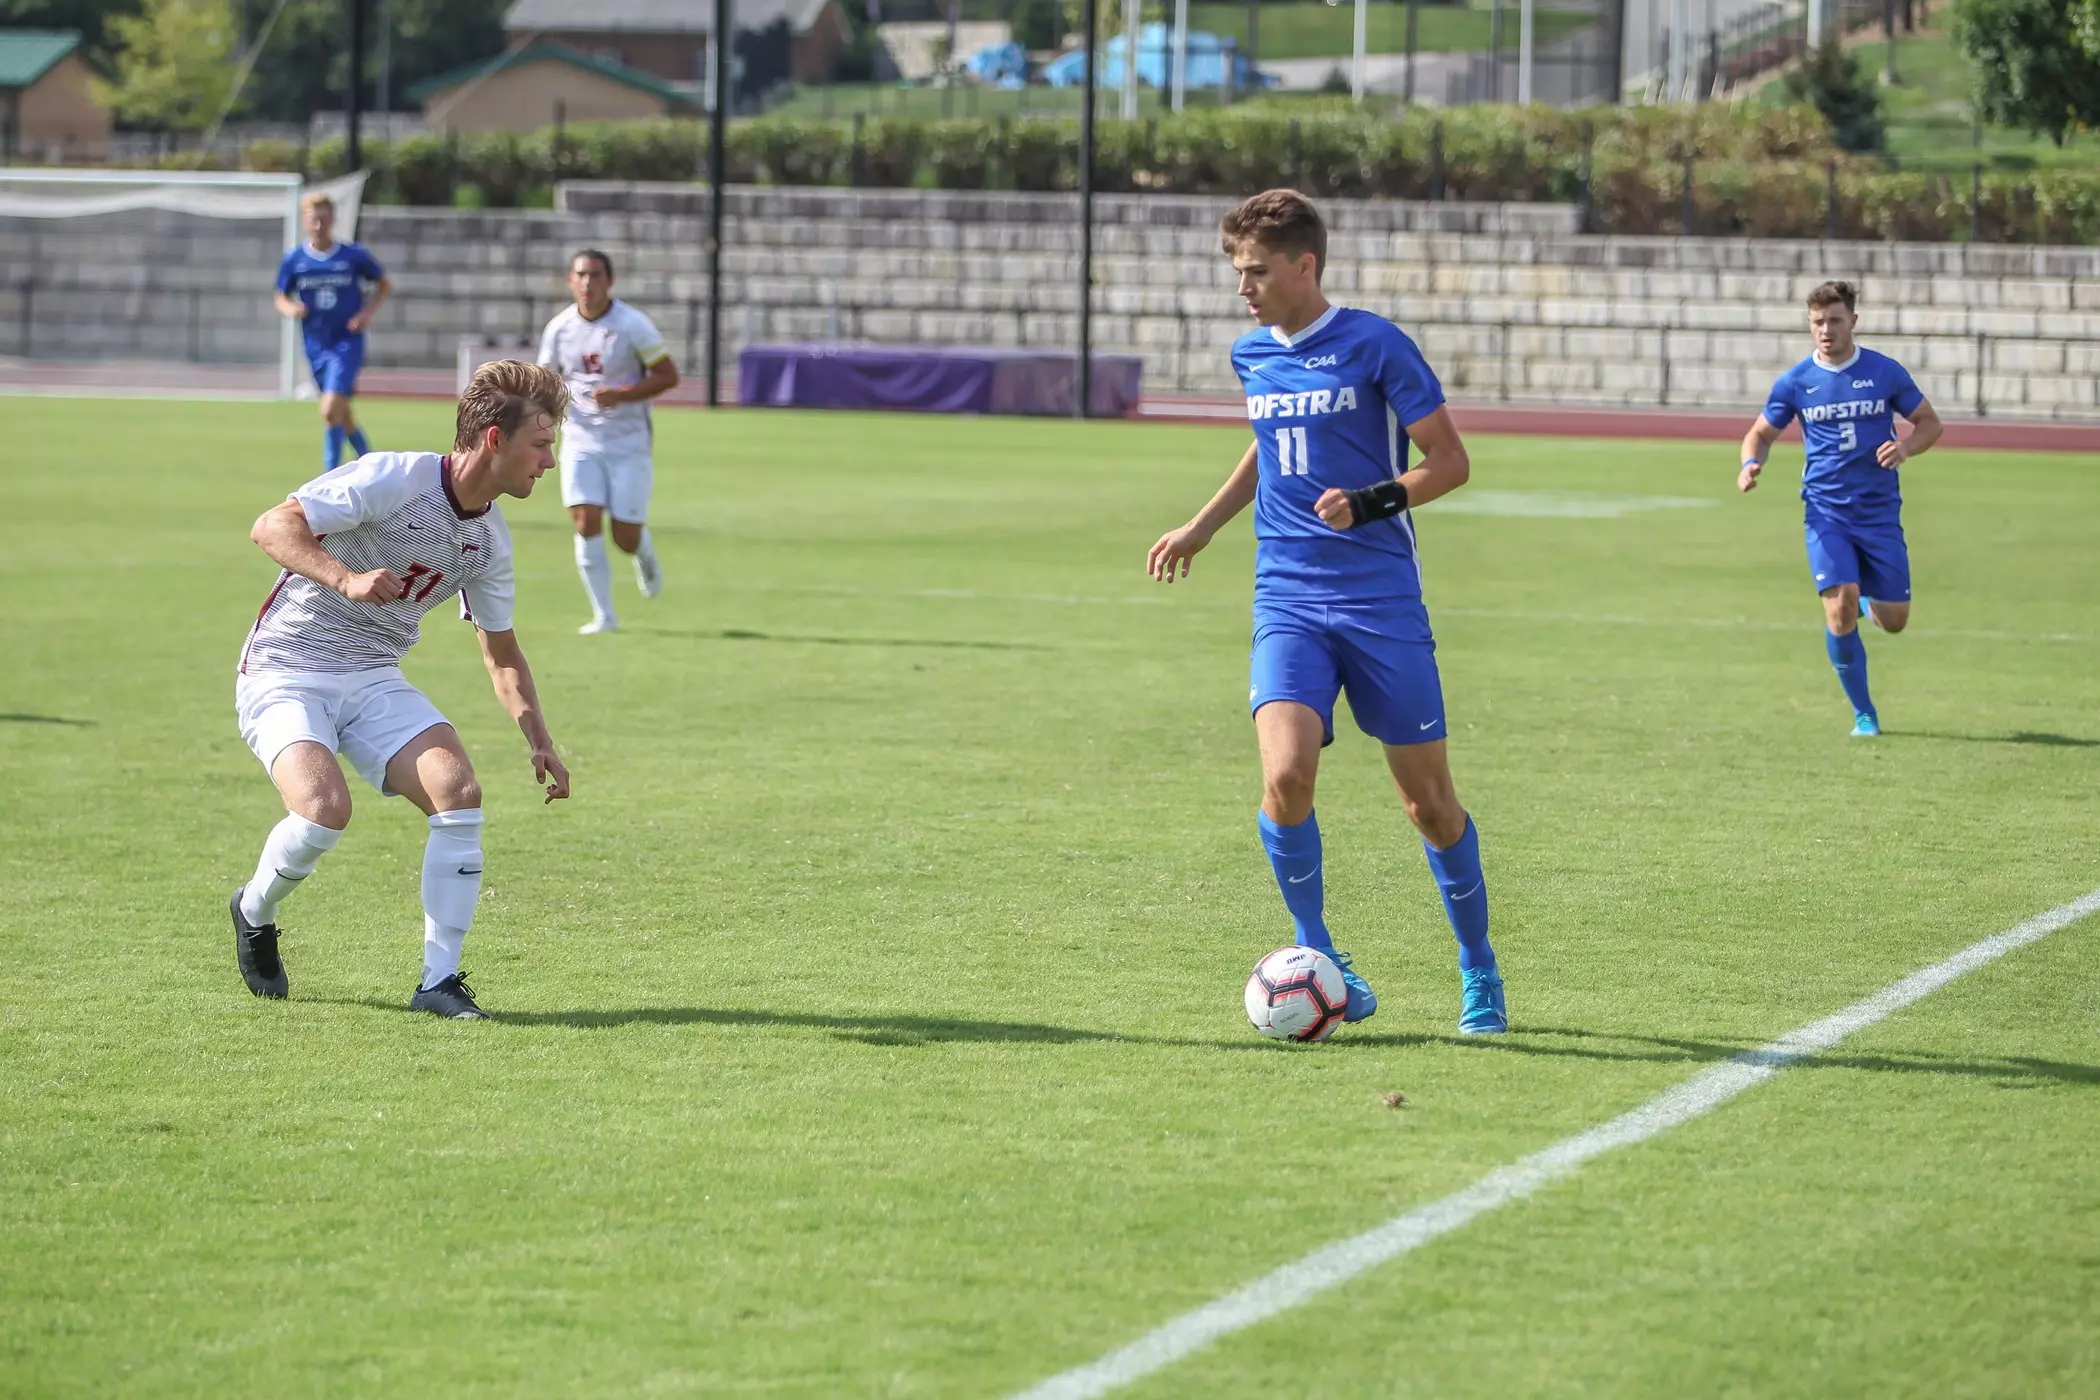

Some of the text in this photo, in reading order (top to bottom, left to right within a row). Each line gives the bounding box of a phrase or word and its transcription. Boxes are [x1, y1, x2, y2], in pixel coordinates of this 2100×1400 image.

[582, 354, 604, 374] 15
[1305, 354, 1337, 369] CAA
[1838, 421, 1857, 451] 3
[1276, 427, 1308, 476] 11
